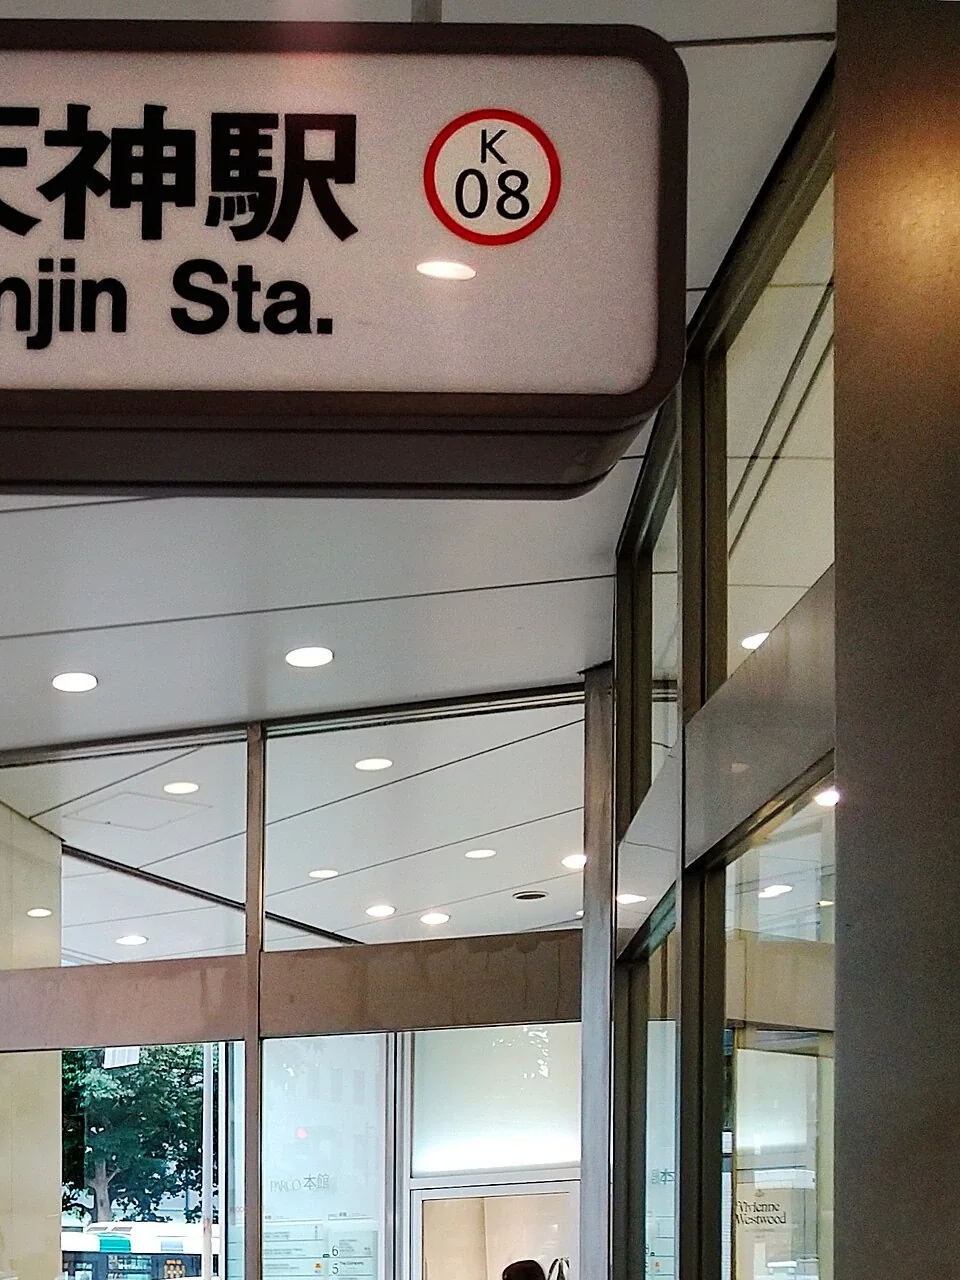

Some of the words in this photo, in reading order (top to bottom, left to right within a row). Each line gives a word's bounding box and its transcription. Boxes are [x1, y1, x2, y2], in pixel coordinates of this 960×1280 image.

[481, 129, 507, 164] K
[455, 168, 530, 219] 08
[171, 258, 334, 335] Sta.
